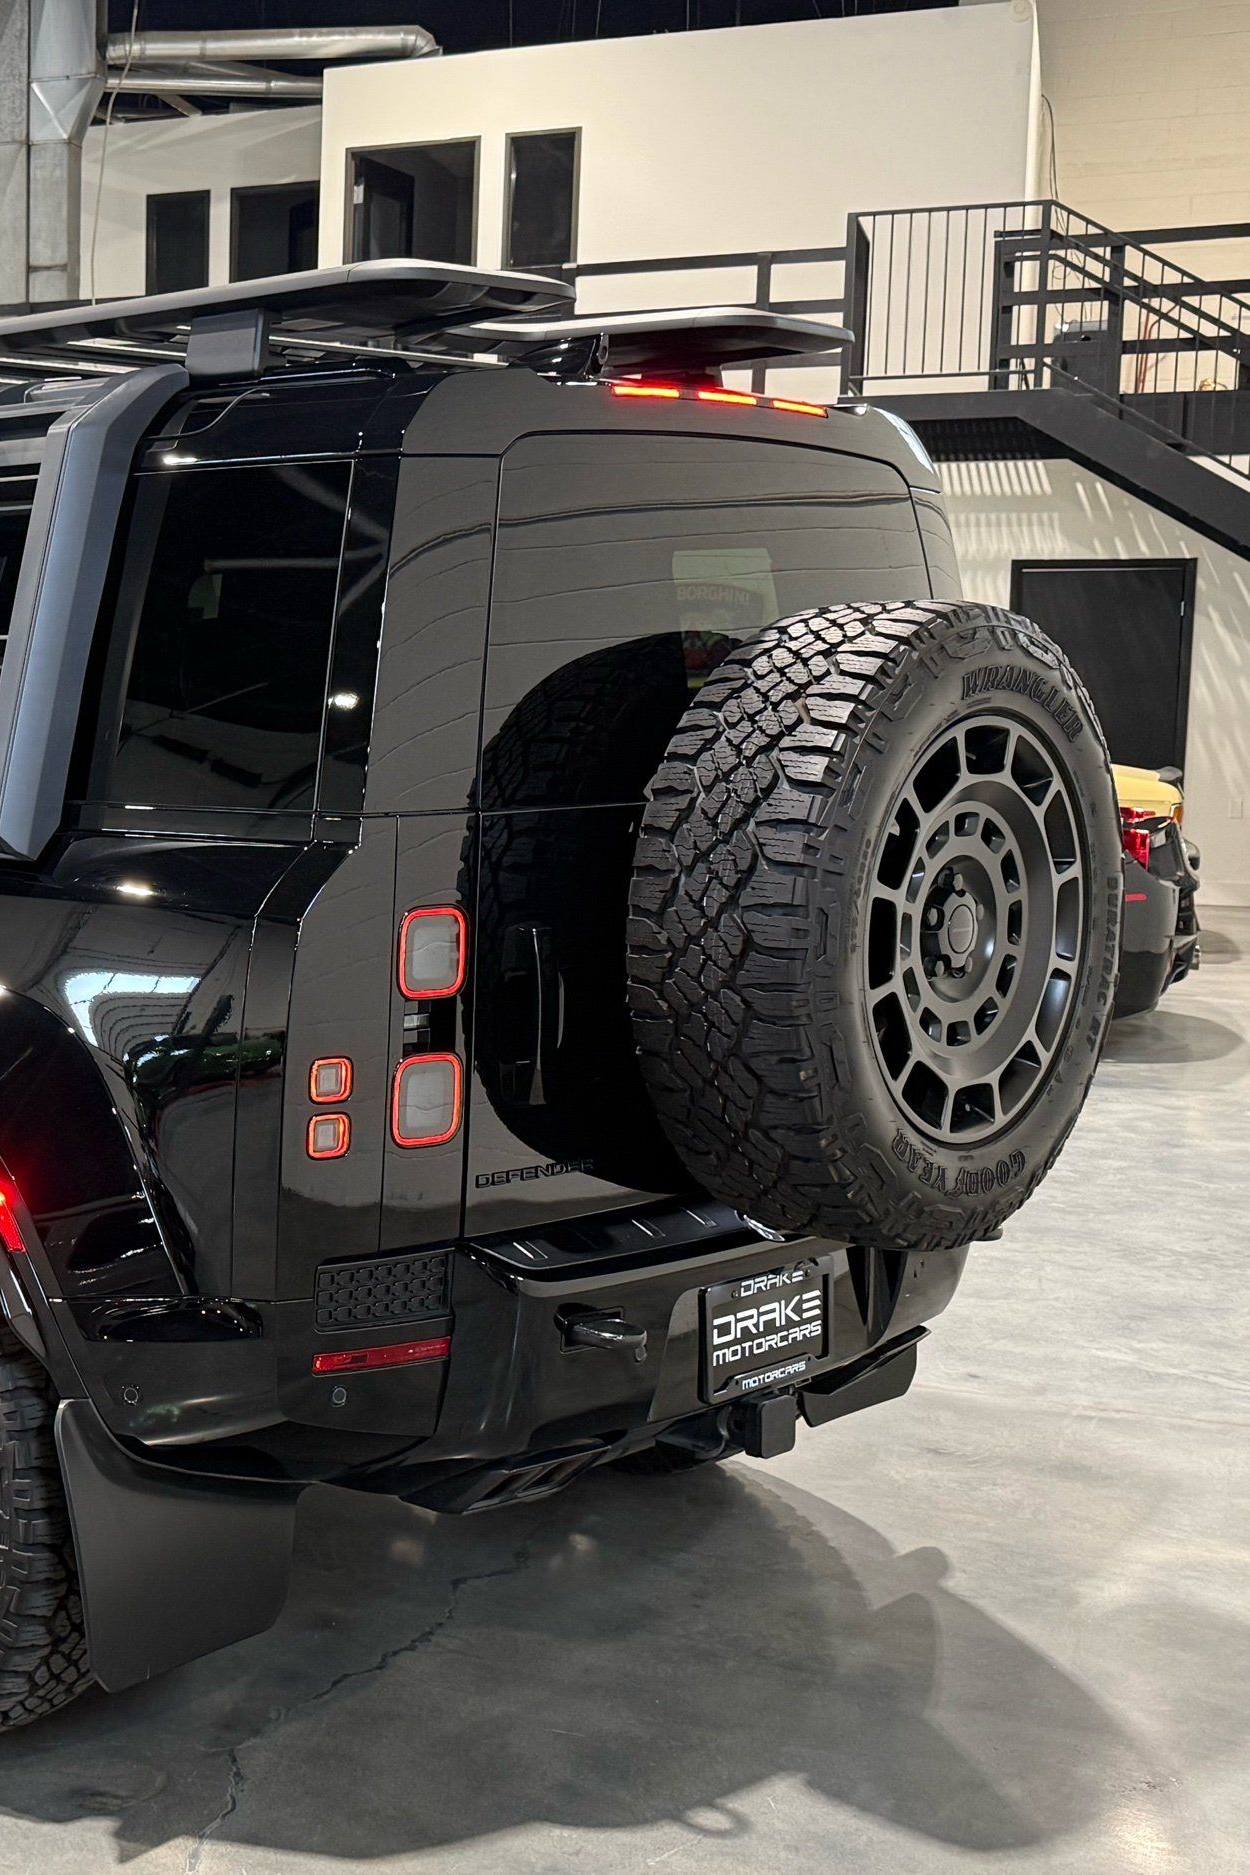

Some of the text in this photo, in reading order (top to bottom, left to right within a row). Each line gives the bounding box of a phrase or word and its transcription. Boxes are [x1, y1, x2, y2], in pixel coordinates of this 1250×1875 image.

[961, 663, 1084, 743] WRANGLER
[1085, 874, 1119, 1055] DURATRAC RT
[474, 1159, 594, 1189] DEFENDER
[891, 1128, 1027, 1200] GOODYEAR
[740, 1270, 804, 1298] DRAKE
[712, 1289, 822, 1346] DRAKE
[712, 1319, 822, 1367] MOTORCARS
[741, 1360, 807, 1390] MOTORCARS
